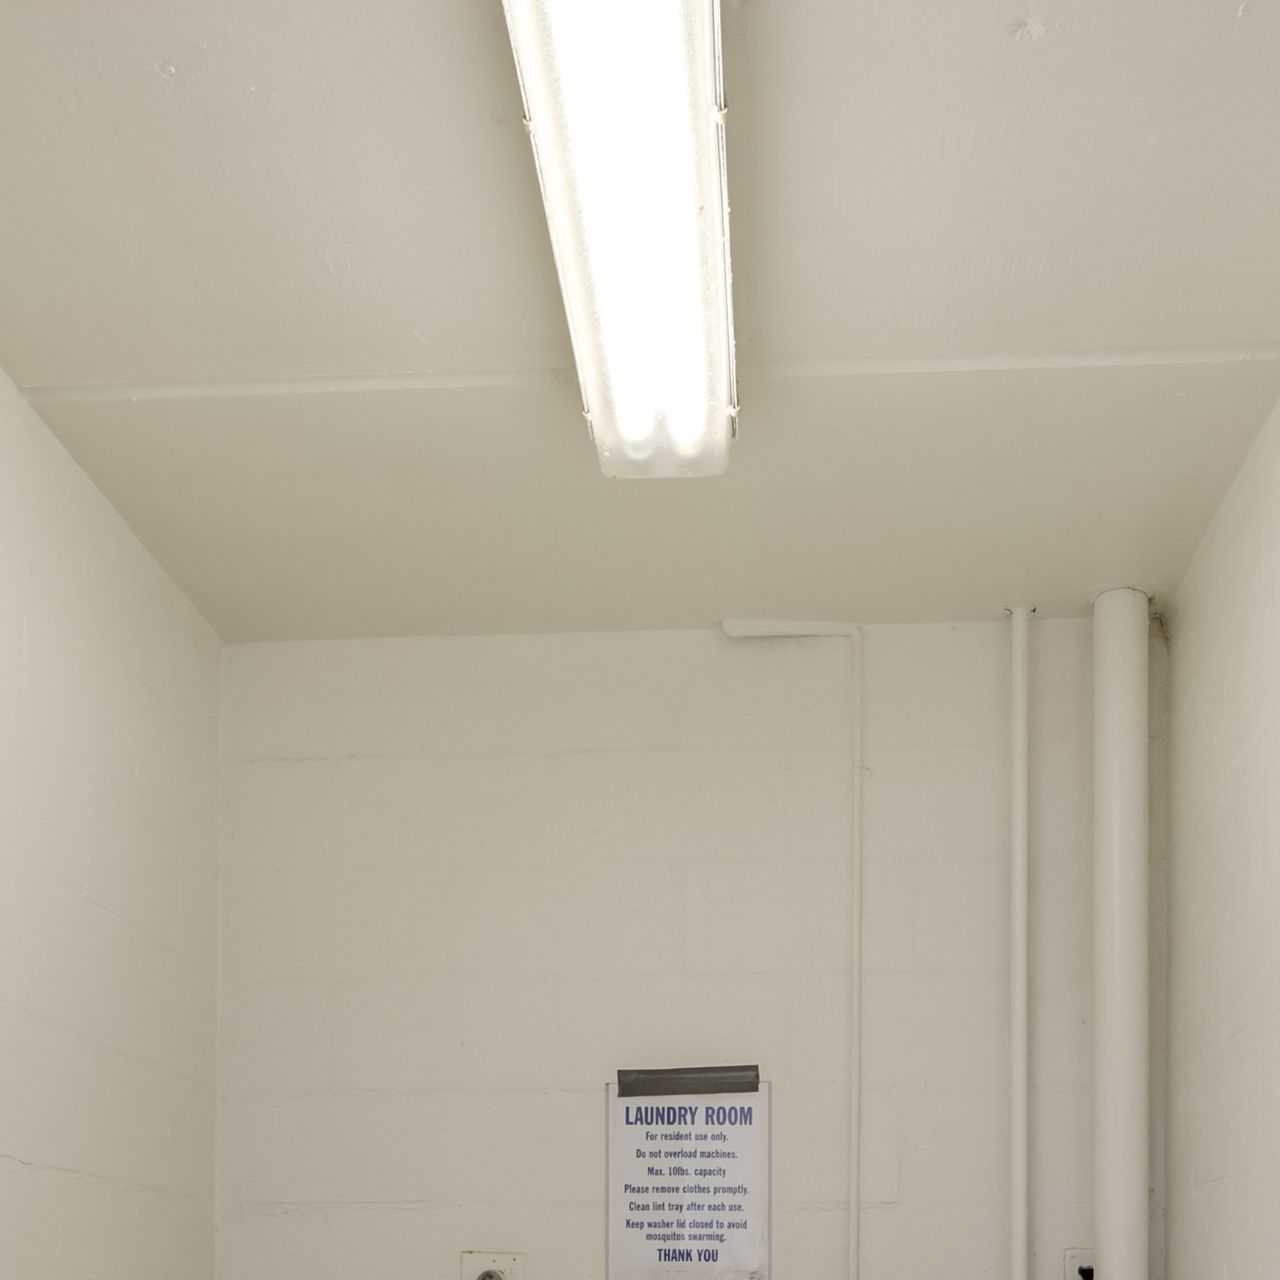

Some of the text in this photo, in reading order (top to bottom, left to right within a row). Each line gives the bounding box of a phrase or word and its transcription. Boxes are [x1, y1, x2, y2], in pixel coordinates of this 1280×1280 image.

[625, 1107, 752, 1125] LAUNDRY ROOM
[646, 1132, 658, 1141] For
[661, 1132, 692, 1141] resident
[711, 1132, 728, 1143] only.
[636, 1150, 738, 1158] Do not overload machines.
[648, 1167, 726, 1178] Max. 10lbs. capacity
[624, 1185, 649, 1194] Please
[683, 1185, 710, 1194] clothes
[714, 1185, 749, 1196] promptly.
[629, 1202, 649, 1211] Clean
[652, 1202, 665, 1211] lint
[668, 1203, 683, 1213] tray
[686, 1202, 704, 1211] after
[708, 1202, 726, 1211] each
[626, 1220, 747, 1230] Keep washer lid closed to avoid
[646, 1233, 685, 1243] mosquitos
[657, 1249, 718, 1262] THANK YOU
